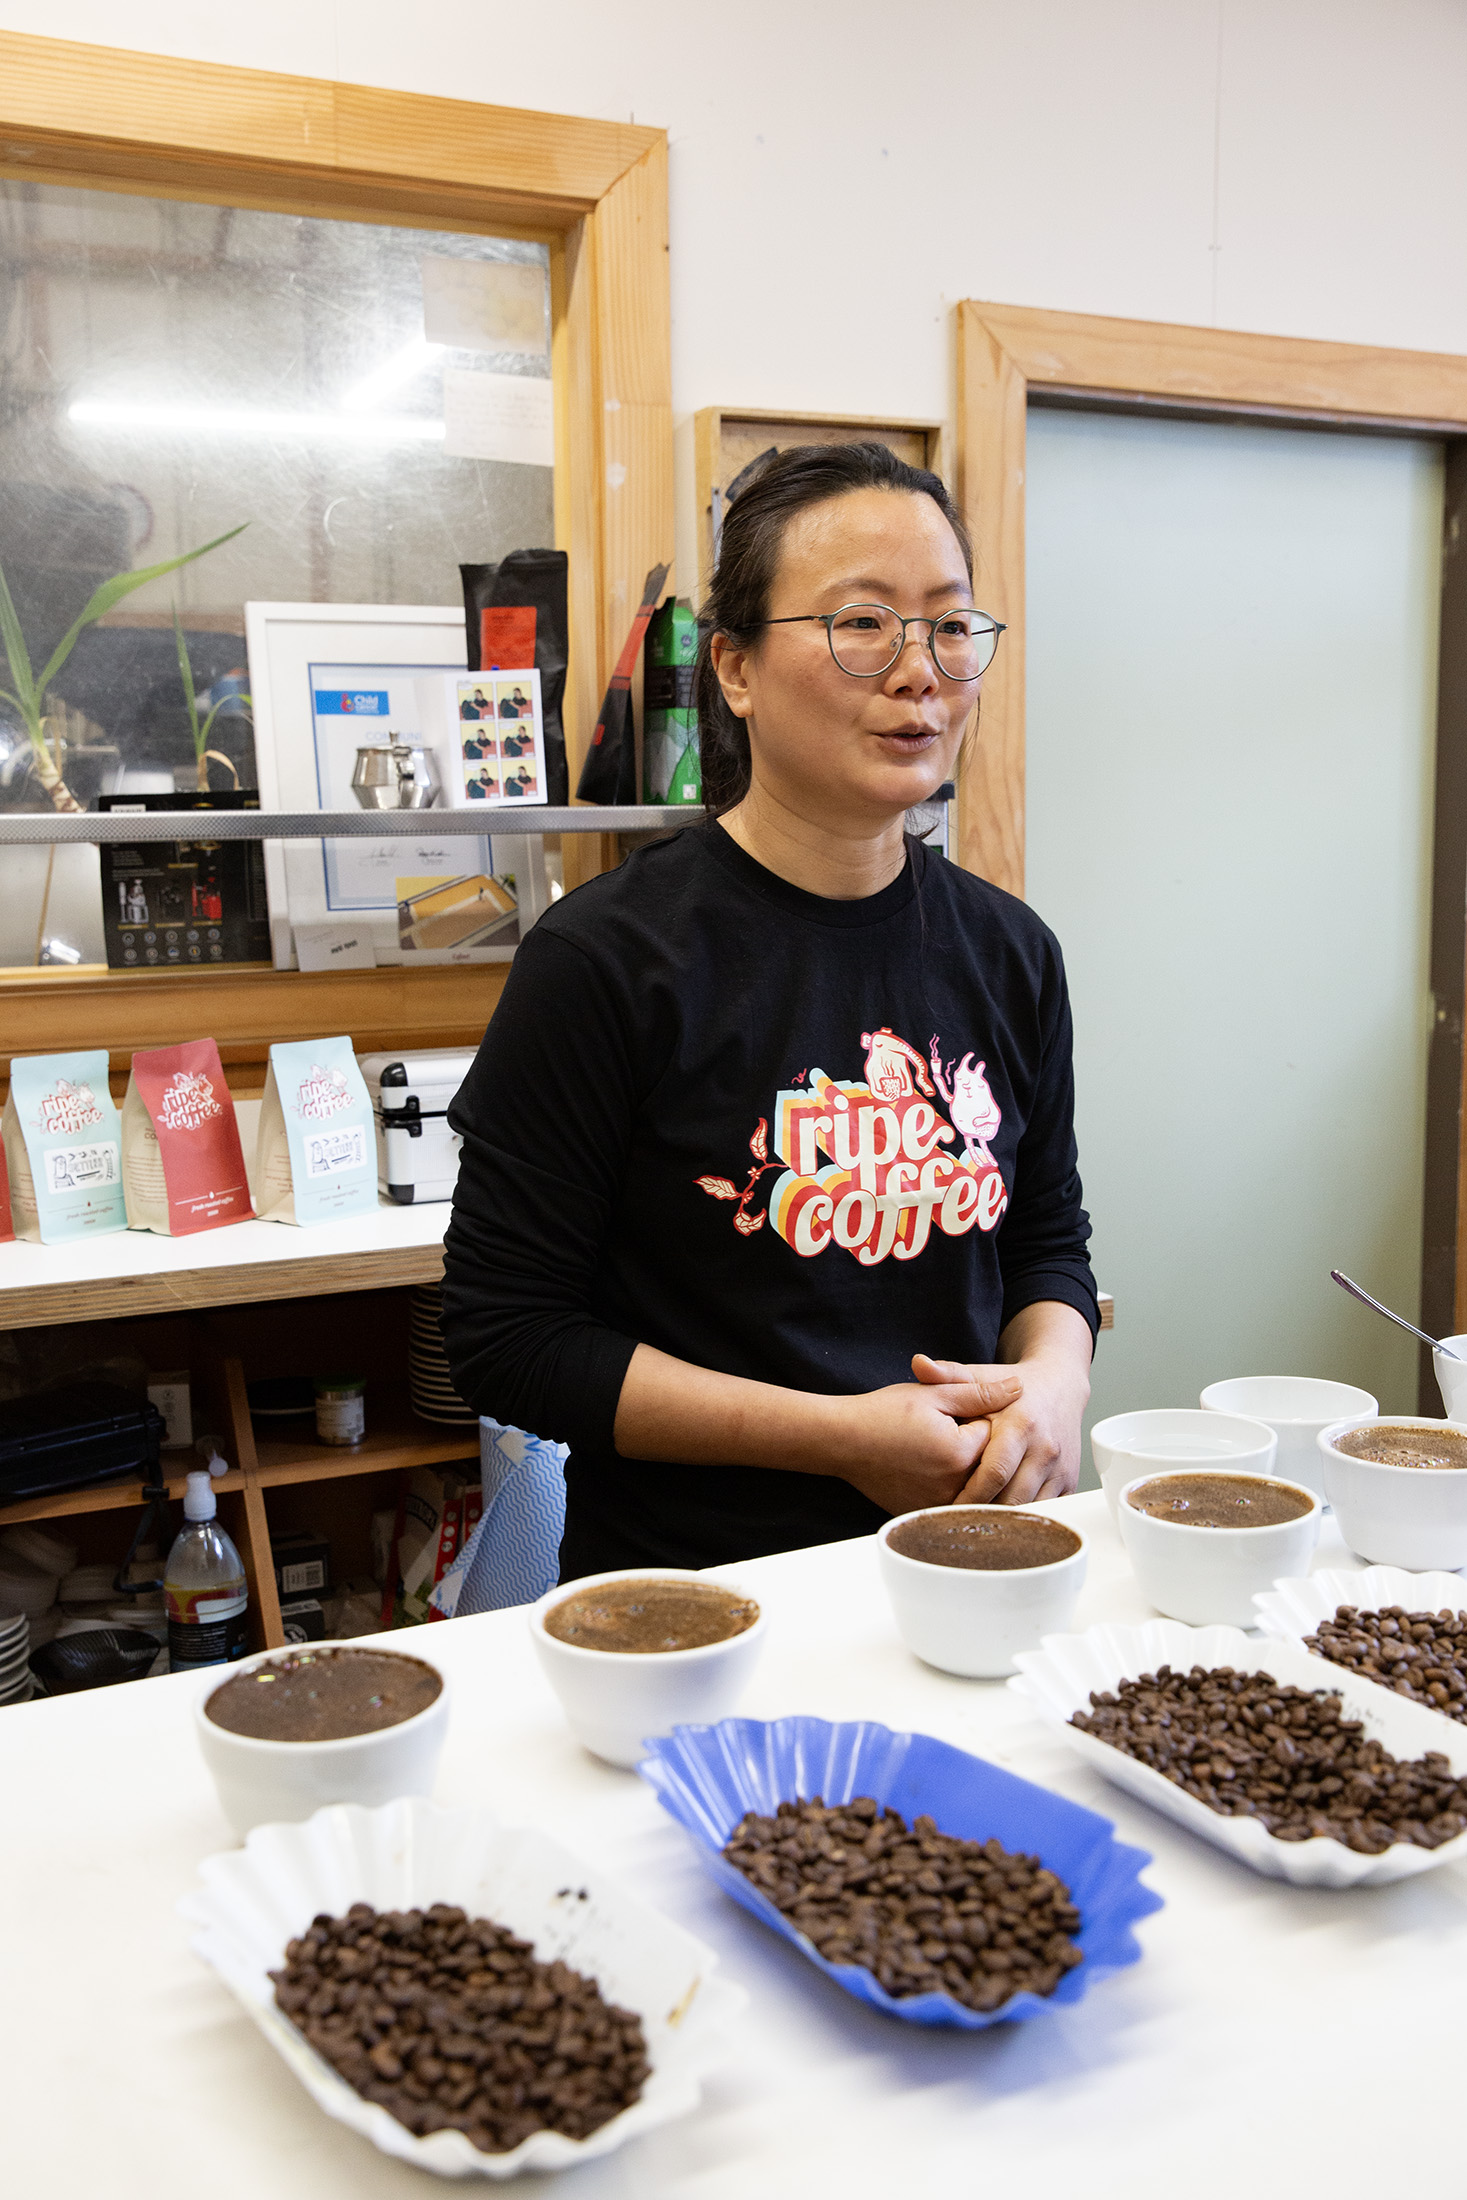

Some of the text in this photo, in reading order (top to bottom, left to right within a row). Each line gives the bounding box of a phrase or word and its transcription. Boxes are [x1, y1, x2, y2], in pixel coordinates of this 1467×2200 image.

[354, 694, 378, 705] Child
[165, 1089, 200, 1113] ripe
[298, 1079, 334, 1101] ripe
[41, 1095, 81, 1119] ripe
[170, 1102, 222, 1131] coffee
[303, 1092, 355, 1120] coffee
[47, 1107, 104, 1135] coffee
[798, 1092, 956, 1189] ripe
[793, 1157, 1009, 1267] coffee
